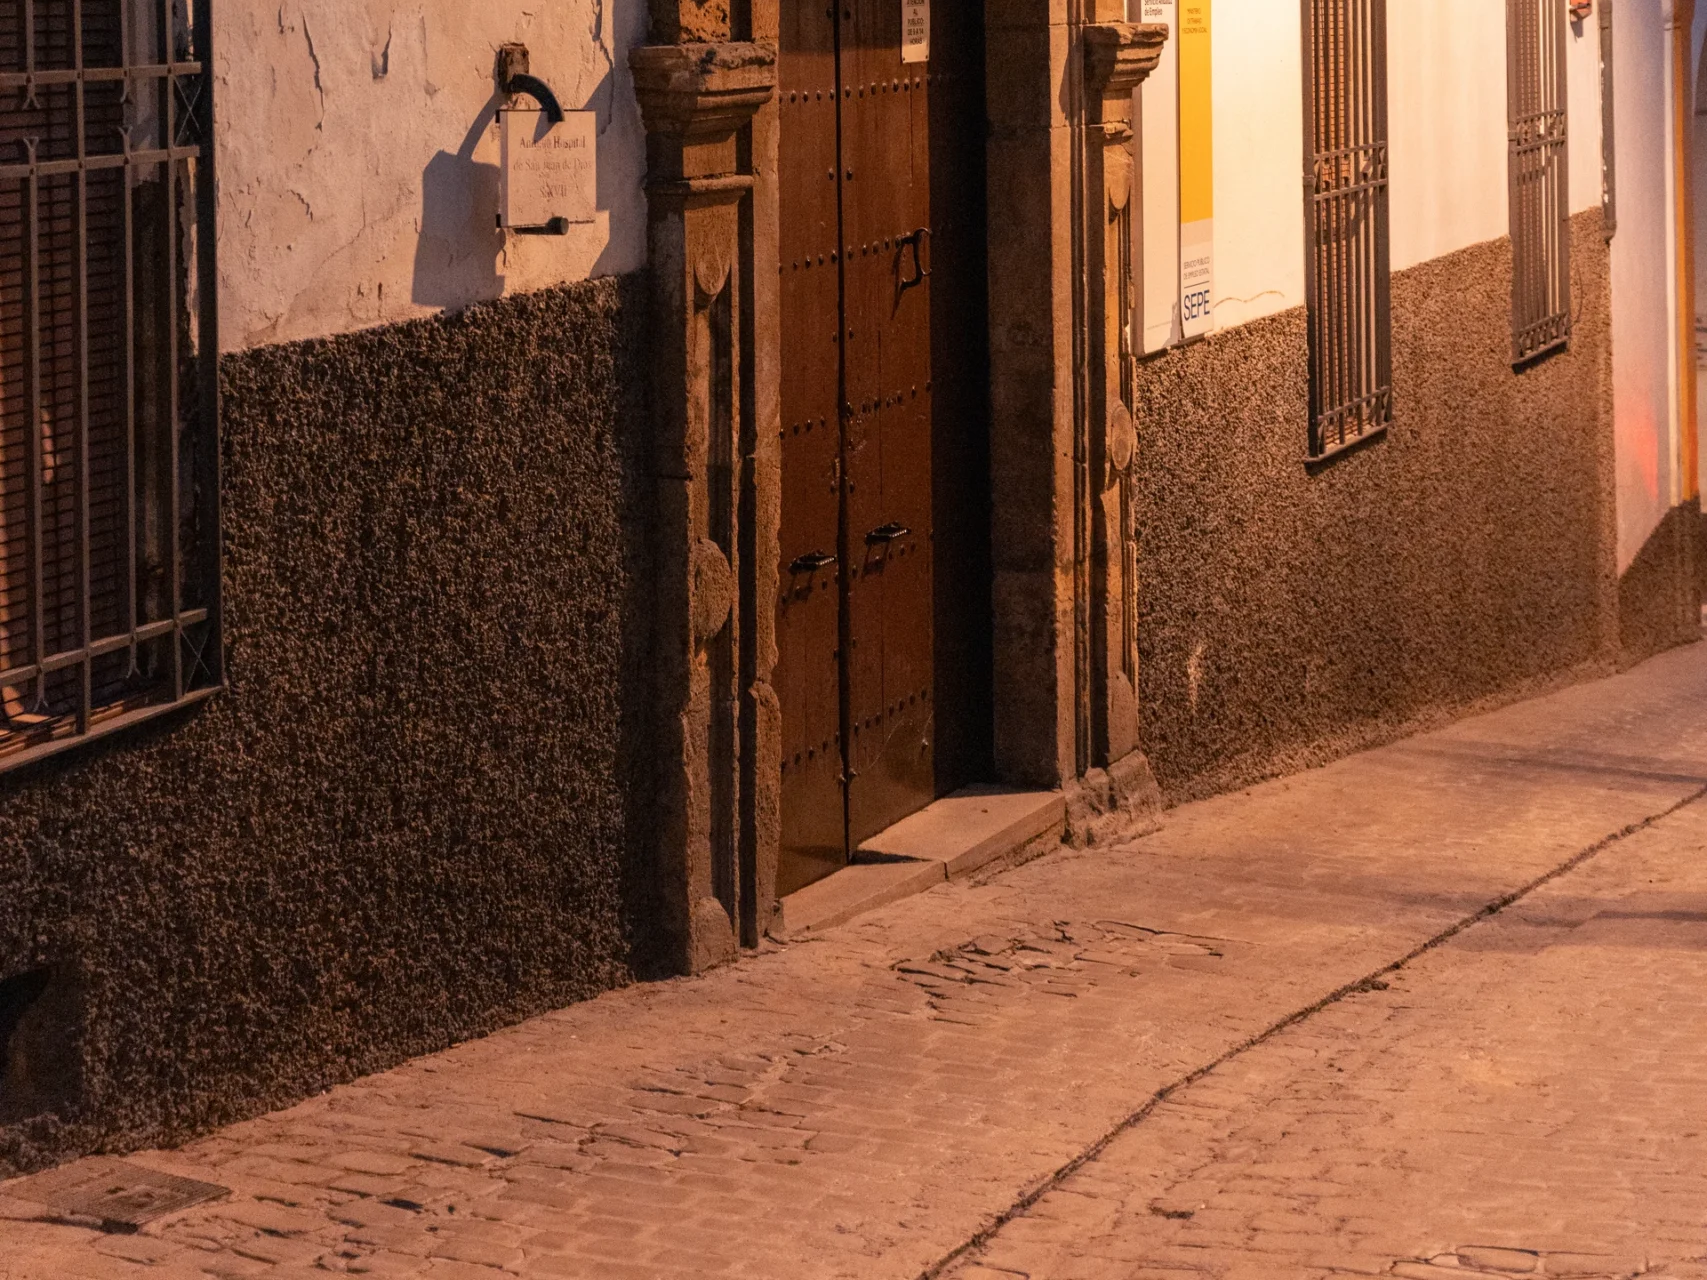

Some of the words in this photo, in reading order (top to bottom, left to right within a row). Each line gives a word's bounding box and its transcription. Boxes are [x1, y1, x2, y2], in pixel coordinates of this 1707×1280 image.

[1144, 7, 1150, 16] de
[1149, 7, 1163, 18] Empleo
[553, 135, 586, 151] Hospital
[525, 158, 540, 171] San
[1183, 289, 1210, 321] SEPE
